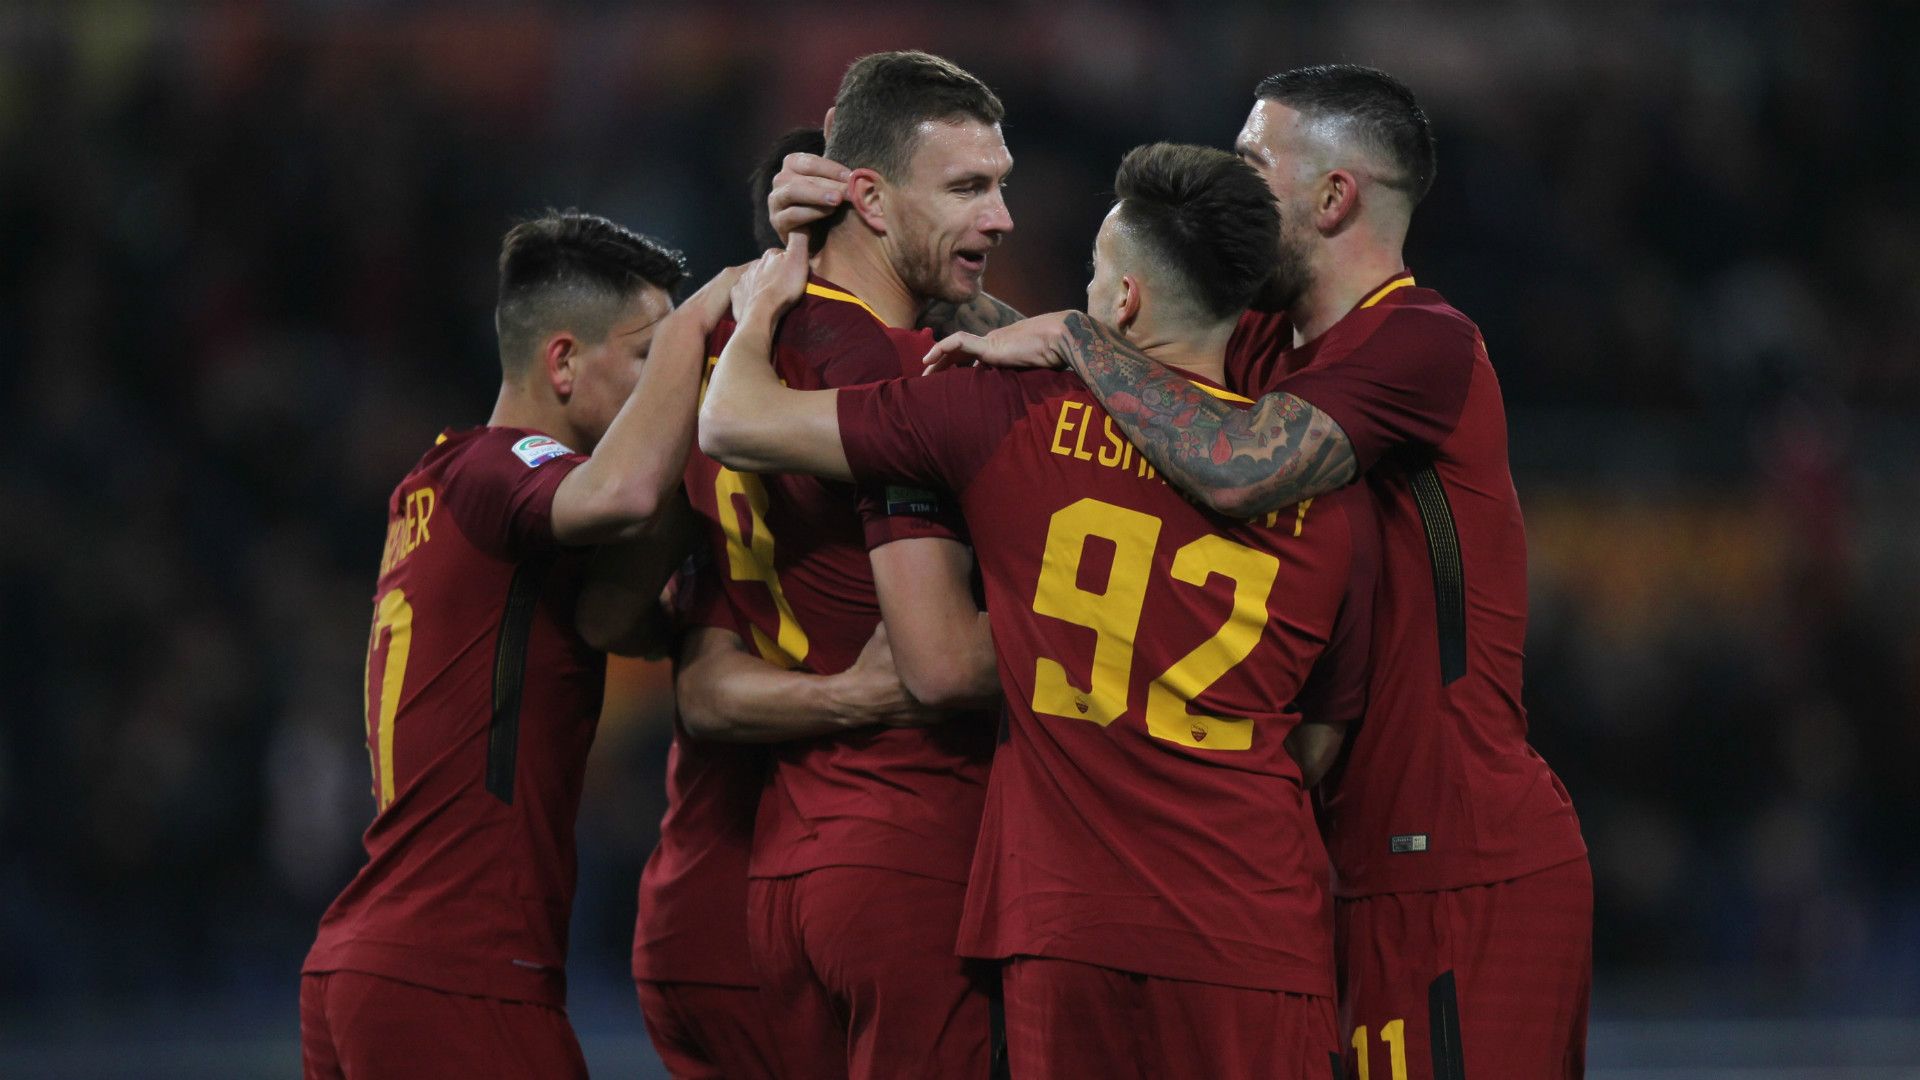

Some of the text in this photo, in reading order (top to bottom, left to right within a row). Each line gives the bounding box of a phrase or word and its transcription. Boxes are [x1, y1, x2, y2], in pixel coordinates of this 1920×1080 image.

[714, 465, 809, 670] 9
[1032, 497, 1280, 750] 92
[1351, 1018, 1408, 1080] 11
